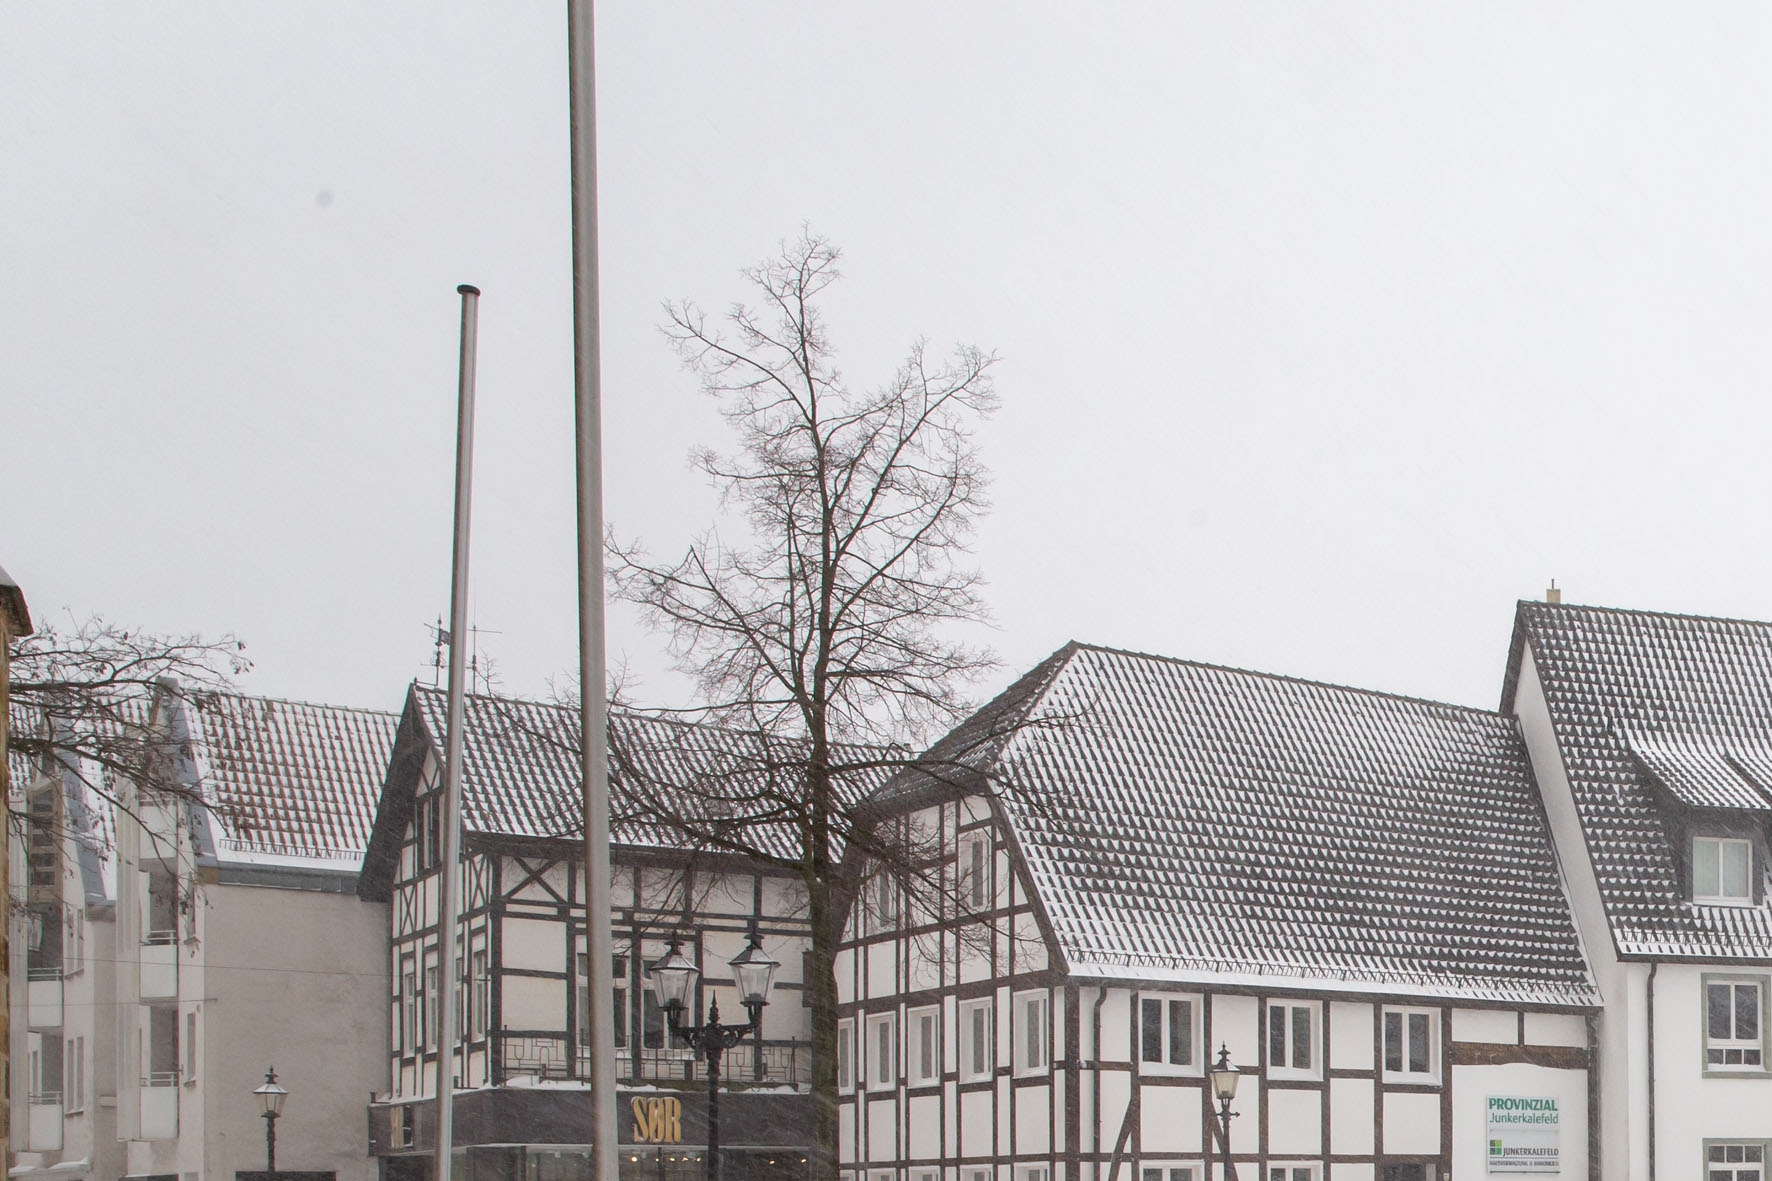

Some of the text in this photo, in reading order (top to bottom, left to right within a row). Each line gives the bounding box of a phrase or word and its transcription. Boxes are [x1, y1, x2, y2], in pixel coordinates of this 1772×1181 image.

[1489, 1098, 1558, 1111] PROVINZIAL
[630, 1096, 682, 1142] SØR
[1489, 1112, 1559, 1124] Junkerkalefeld
[1503, 1147, 1559, 1157] JUNKERKALEFELD
